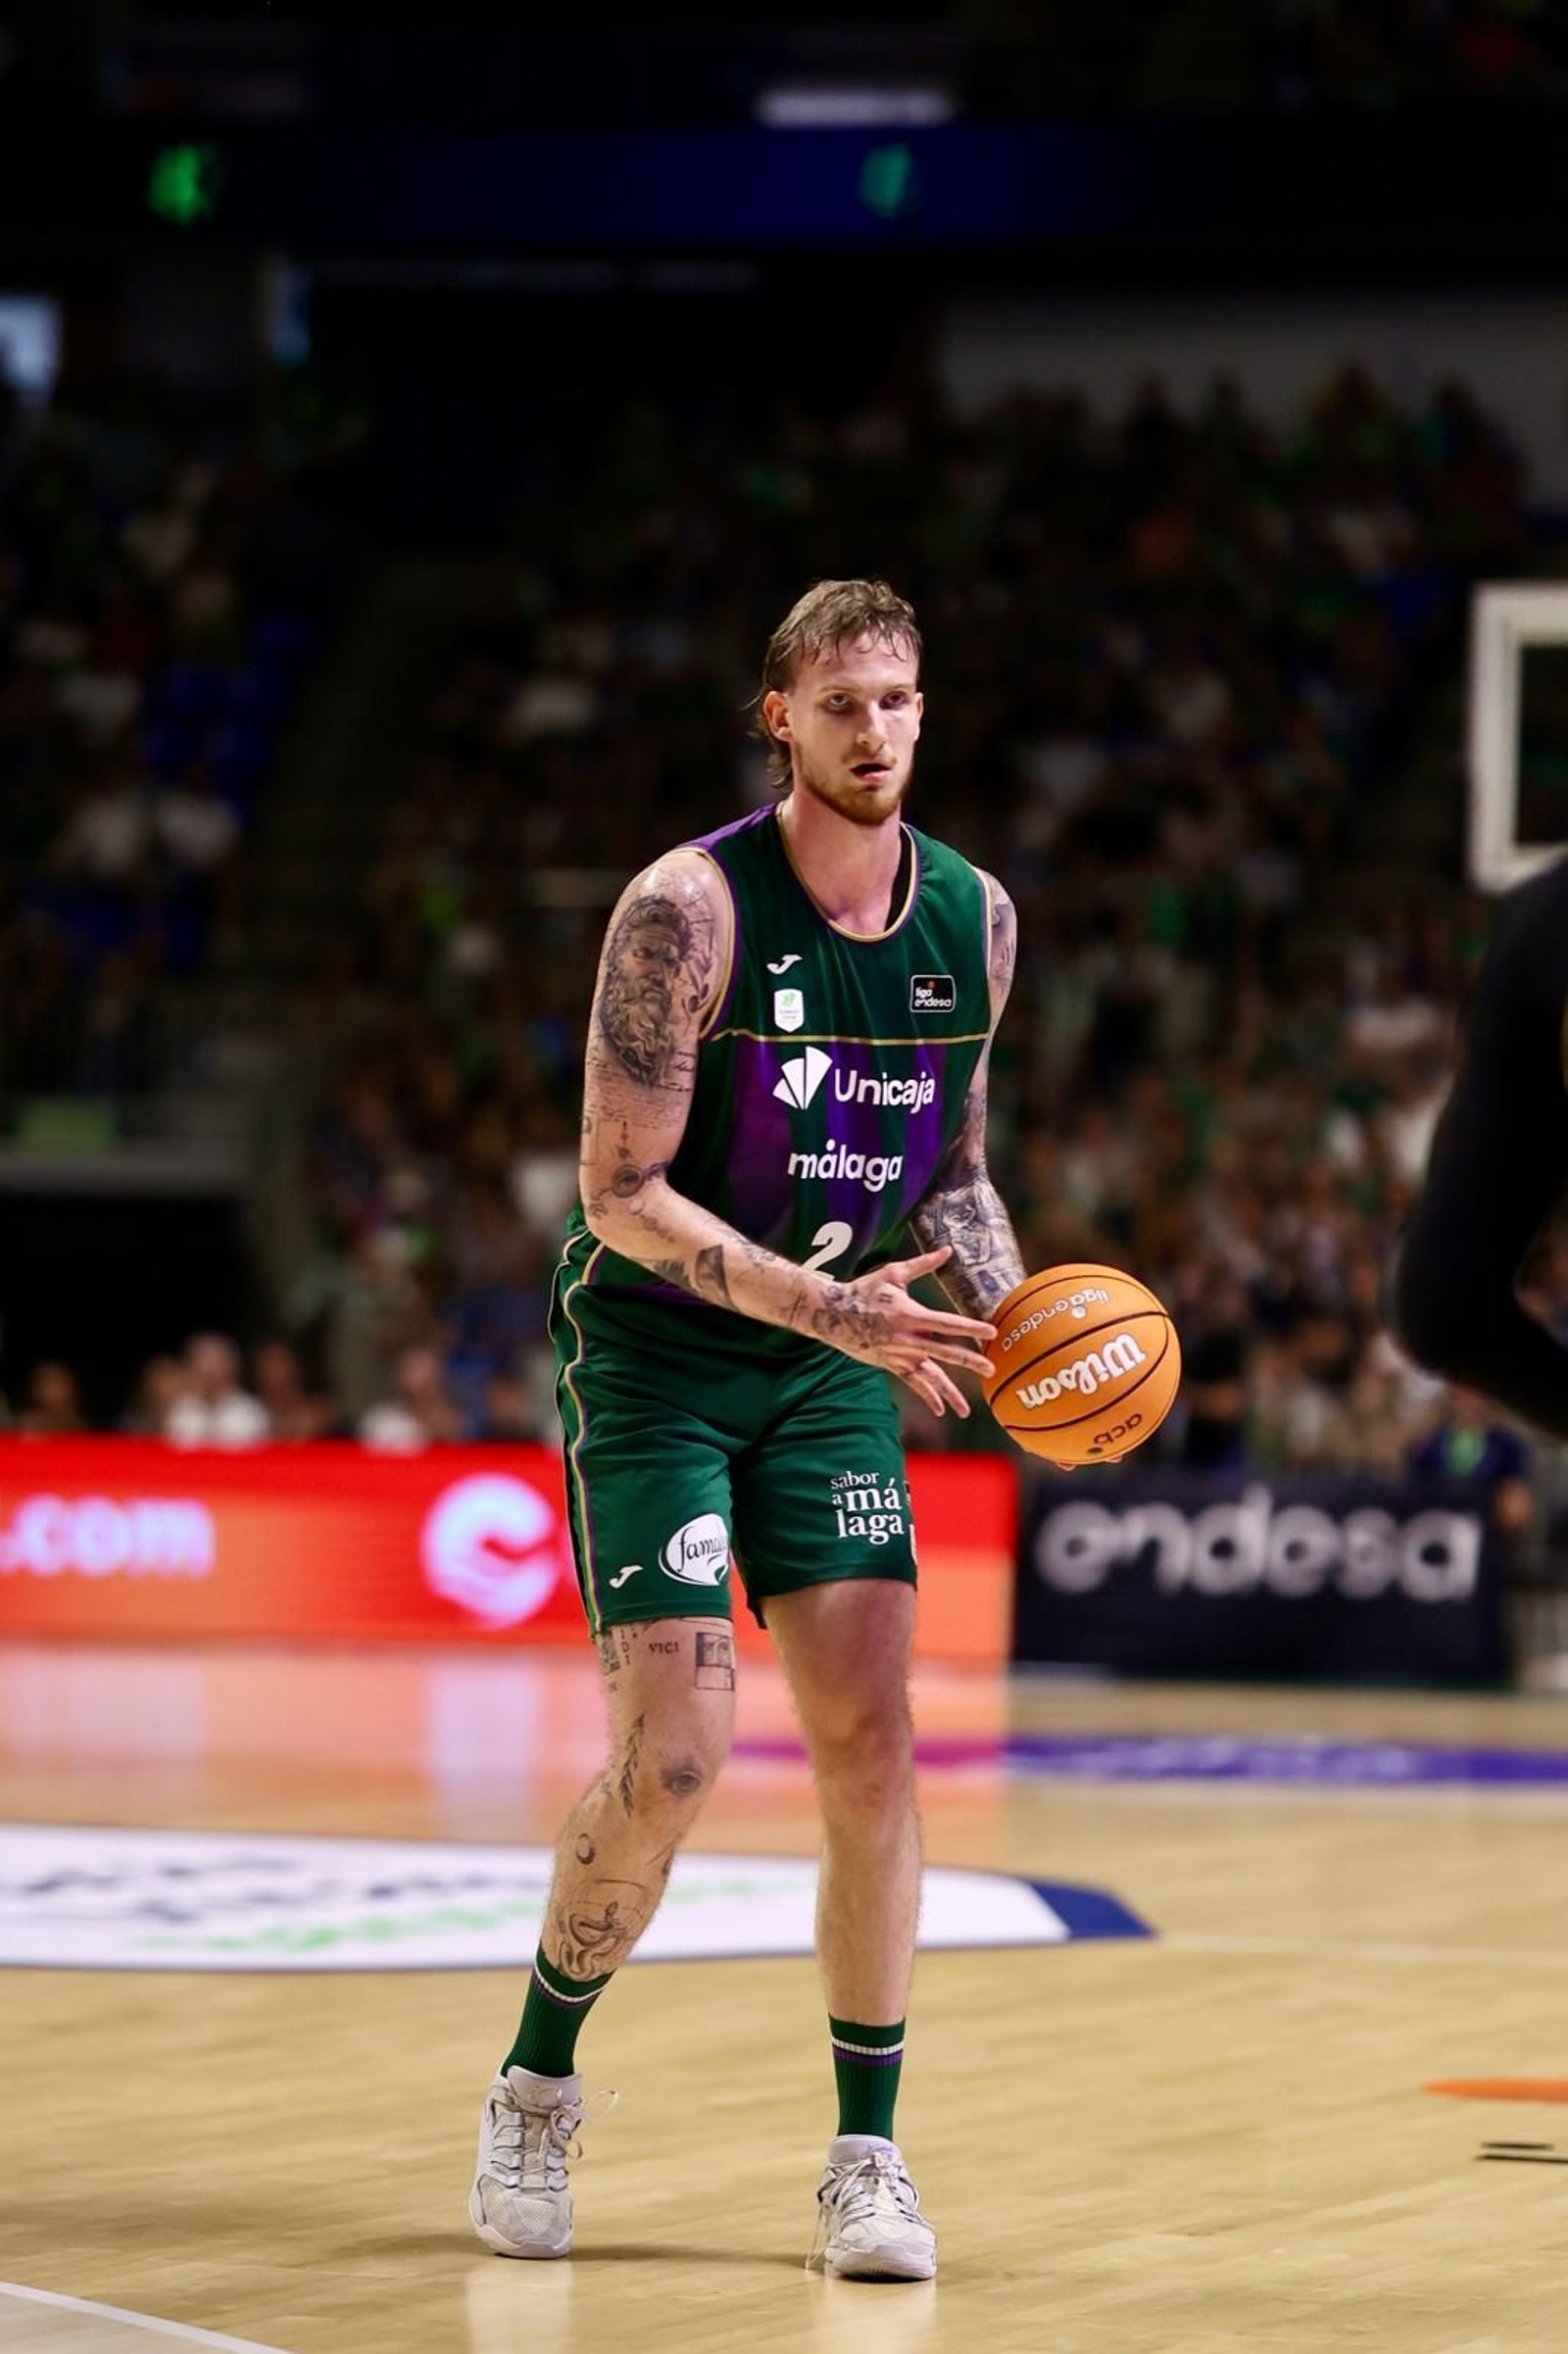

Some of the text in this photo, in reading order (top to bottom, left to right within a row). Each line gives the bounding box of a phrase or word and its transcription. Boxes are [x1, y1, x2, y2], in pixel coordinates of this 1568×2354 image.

[914, 997, 952, 1007] endesa
[834, 1069, 935, 1114] Unicaja
[788, 1139, 903, 1192] málaga
[801, 1221, 854, 1281] 2
[1015, 1334, 1147, 1409] Wilson
[1094, 1413, 1143, 1445] acb
[830, 1470, 880, 1490] sabor
[831, 1494, 844, 1505] a
[844, 1478, 903, 1512] má
[835, 1509, 905, 1545] laga
[1036, 1484, 1481, 1601] endesa
